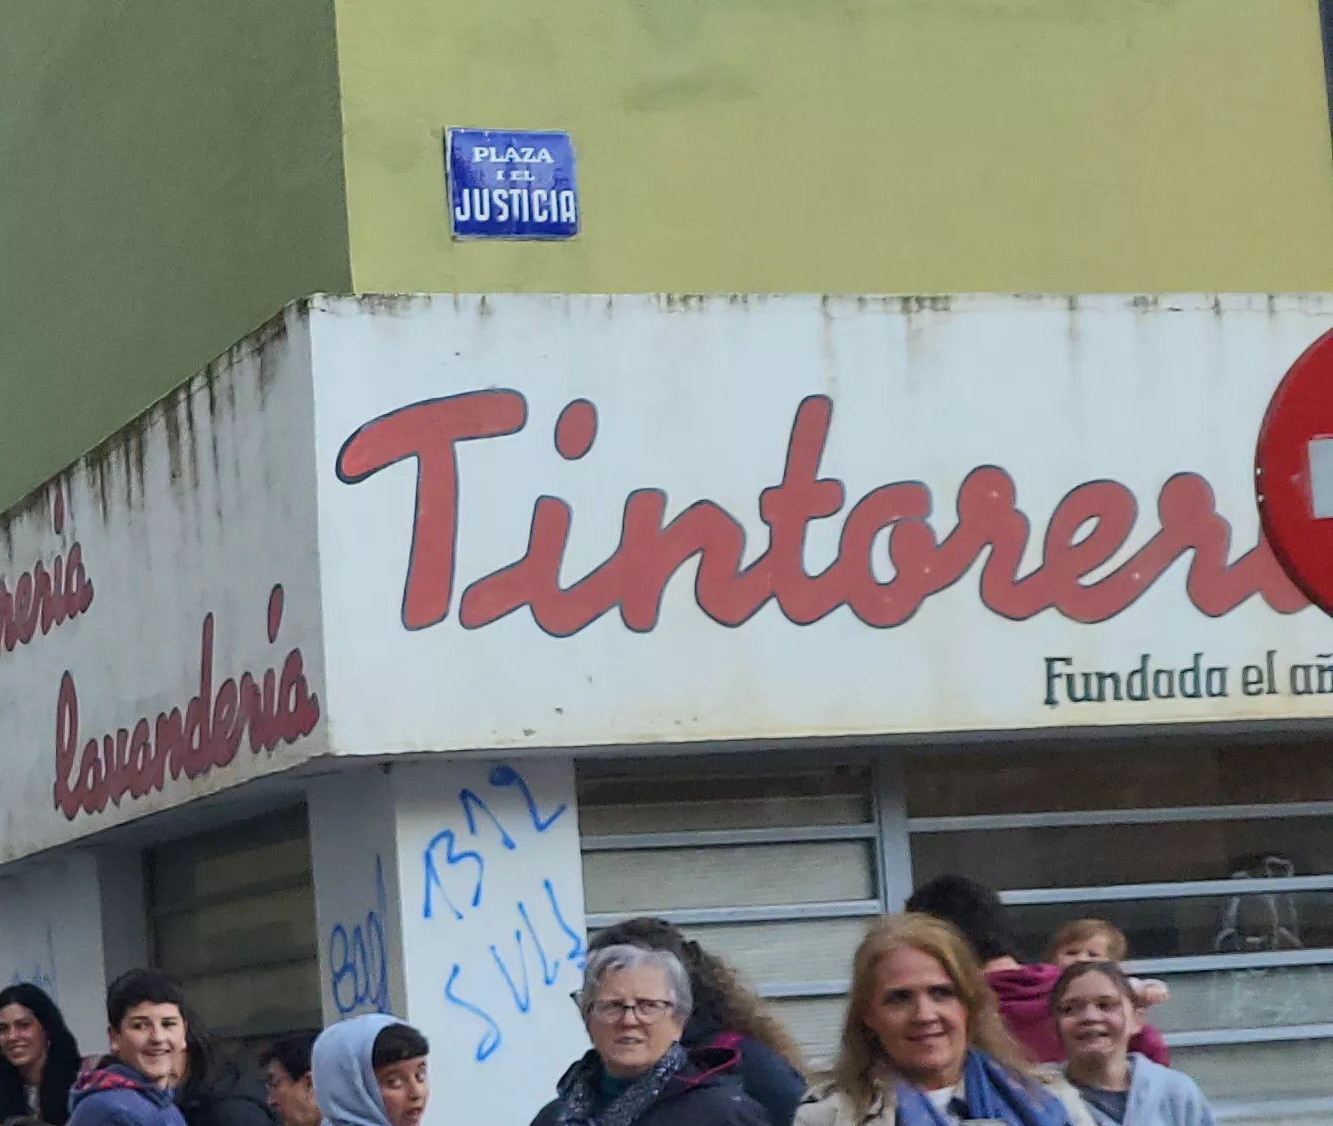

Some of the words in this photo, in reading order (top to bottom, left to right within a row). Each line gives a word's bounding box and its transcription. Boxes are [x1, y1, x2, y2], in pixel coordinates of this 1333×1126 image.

[472, 147, 555, 163] PLAZA
[455, 188, 576, 223] JUSTICIA
[1043, 652, 1229, 706] Fundada
[1241, 650, 1277, 696] el
